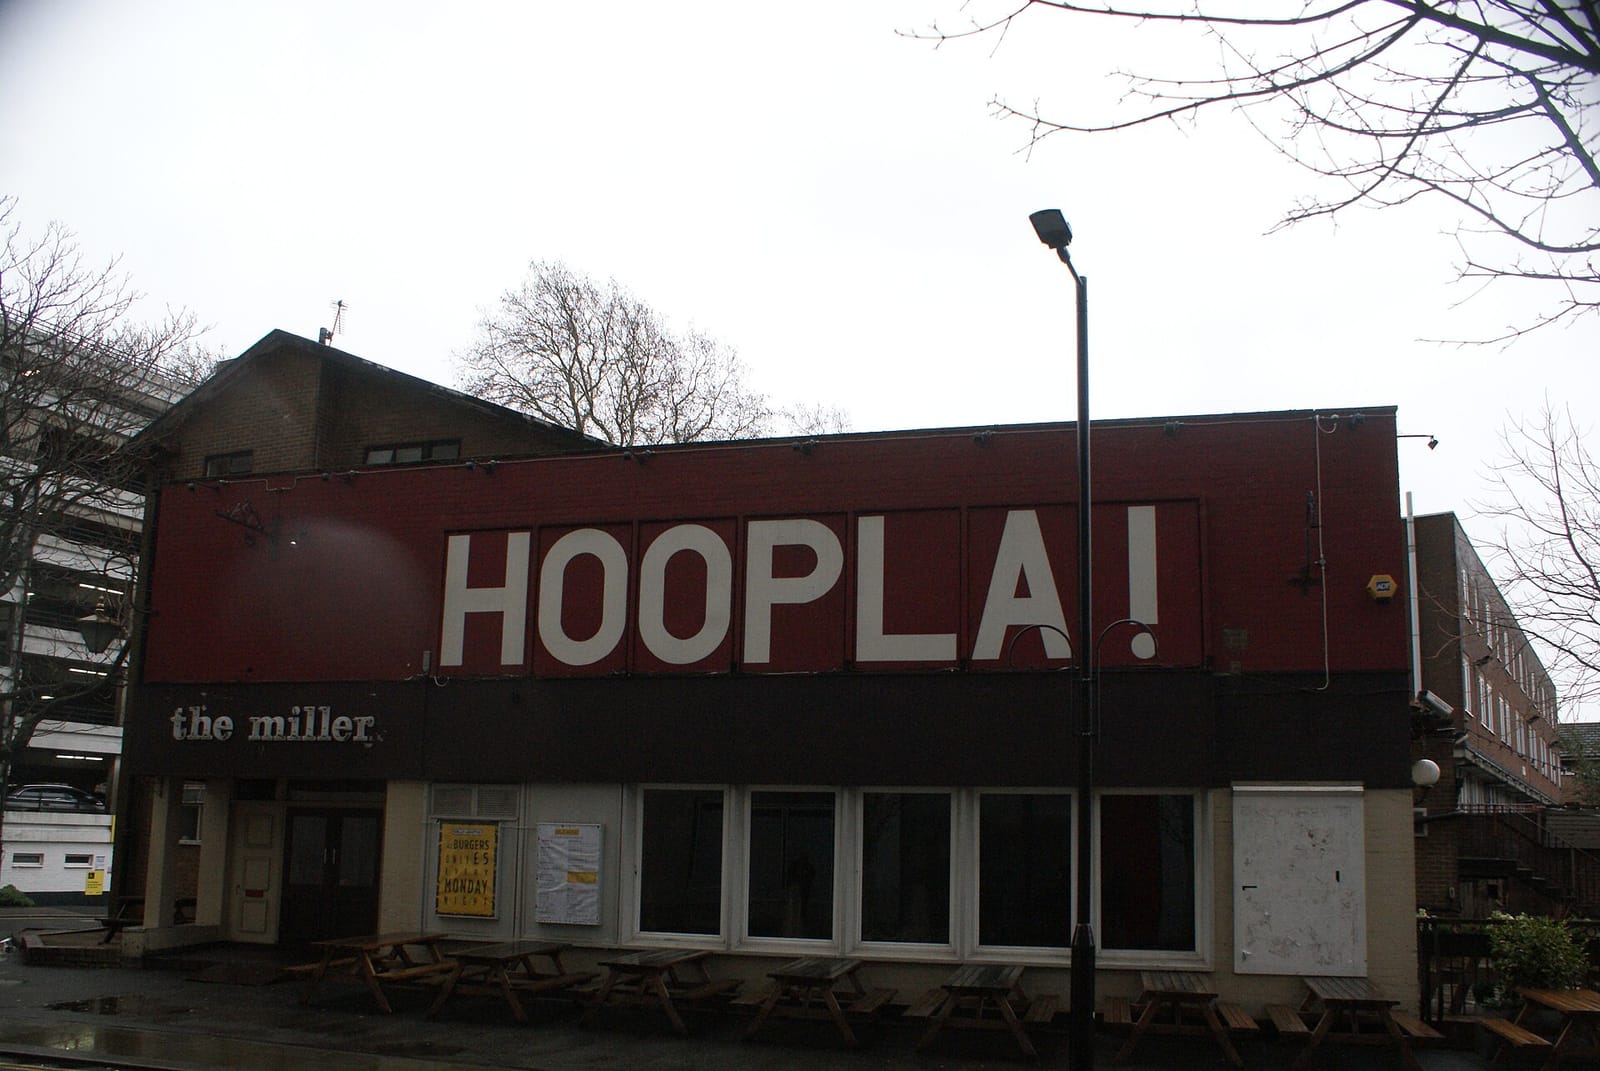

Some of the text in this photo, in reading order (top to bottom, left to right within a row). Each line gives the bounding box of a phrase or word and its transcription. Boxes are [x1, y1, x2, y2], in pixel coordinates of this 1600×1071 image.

[439, 505, 1159, 666] HOOPLA!
[171, 706, 234, 741] the
[453, 839, 490, 850] BURGERS
[444, 879, 488, 895] MONDAY
